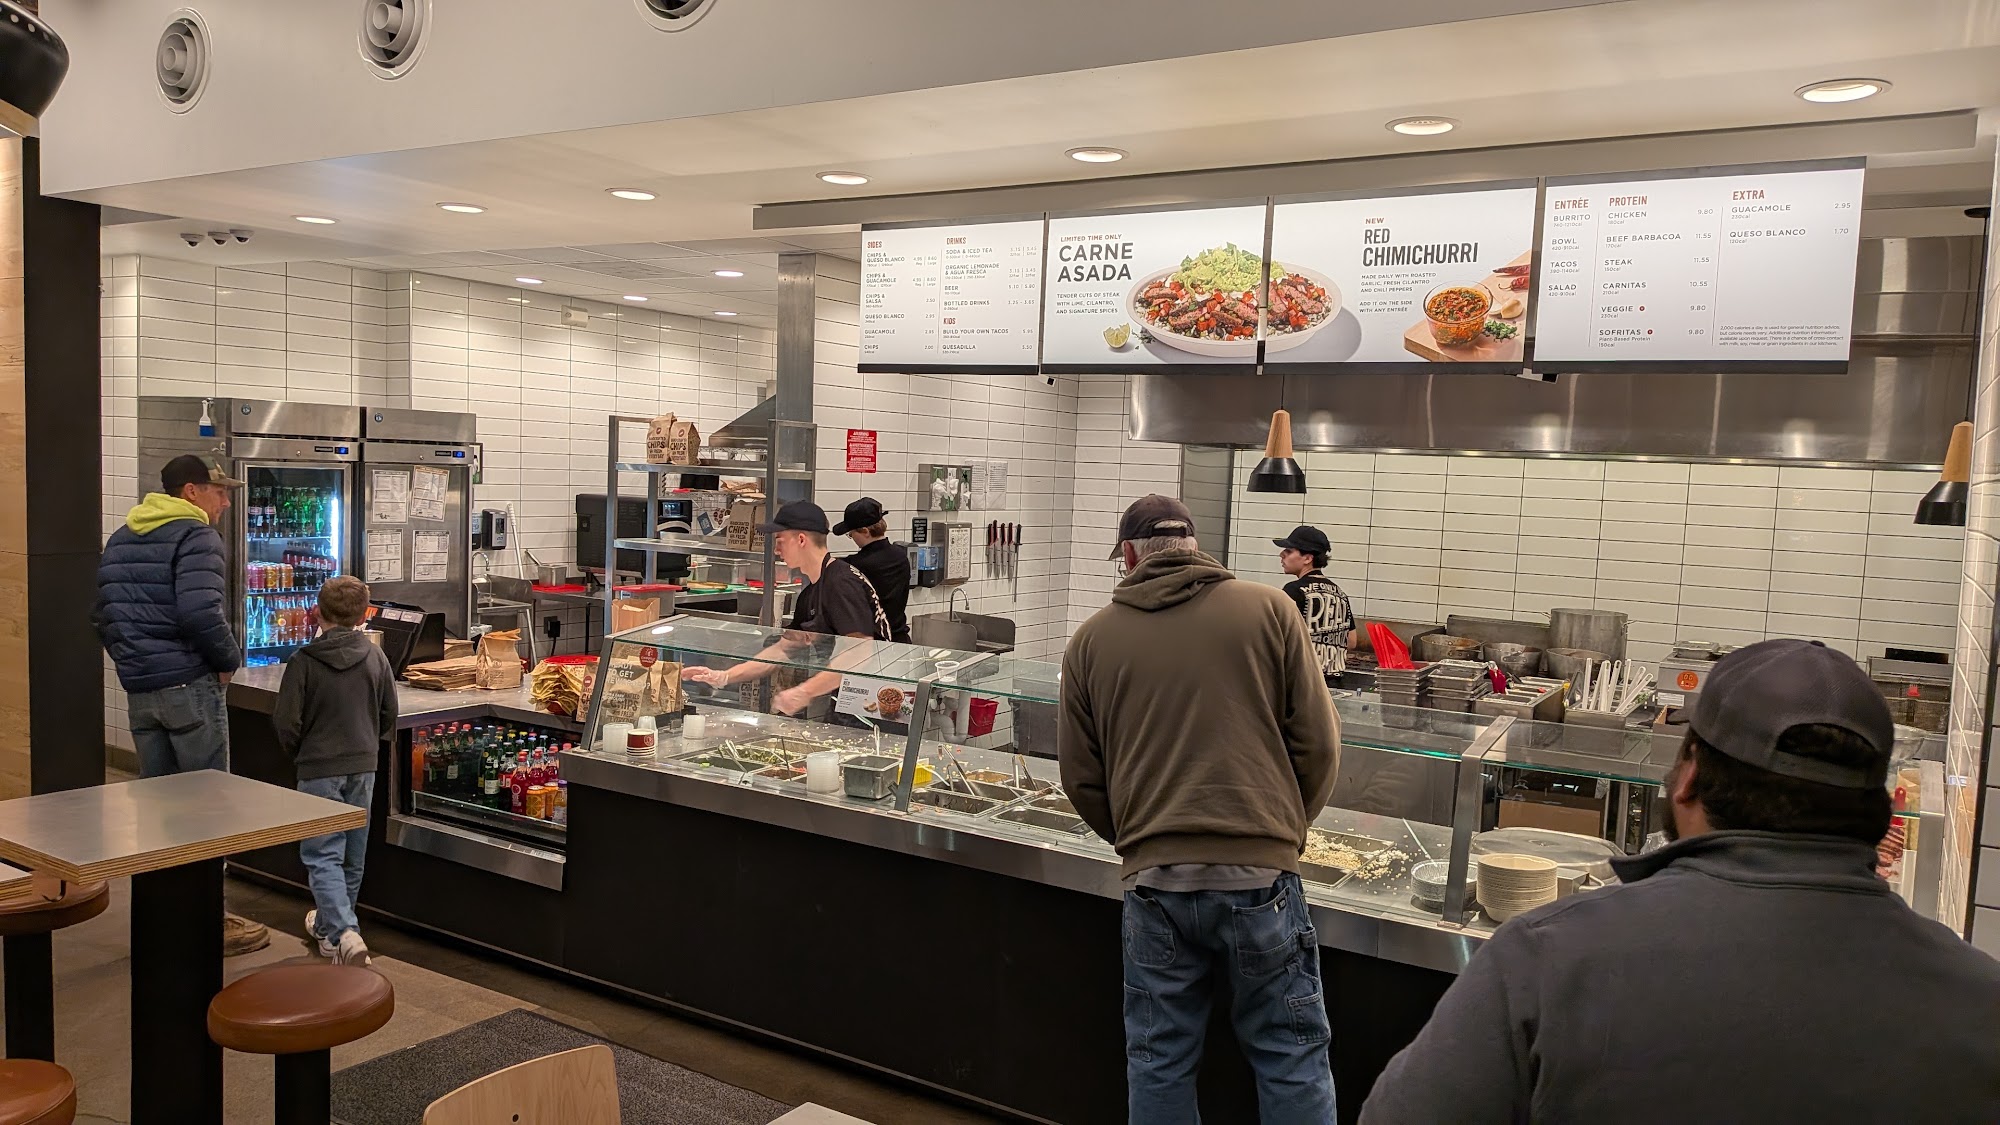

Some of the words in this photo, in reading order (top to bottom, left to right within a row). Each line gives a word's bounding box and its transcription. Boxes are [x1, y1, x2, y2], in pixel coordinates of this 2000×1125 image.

[1733, 190, 1764, 201] EXTRA
[1555, 197, 1589, 209] ENTRÉE
[1609, 196, 1648, 207] PROTEIN
[1732, 204, 1791, 213] GUACAMOLE
[1364, 228, 1390, 244] RED
[1059, 242, 1134, 262] CARNE
[1362, 242, 1479, 267] CHIMICHURRI
[1057, 264, 1132, 283] ASADA
[728, 526, 749, 534] CHIPS
[1300, 583, 1318, 593] WE
[1306, 592, 1351, 632] REAL
[620, 670, 634, 678] GET
